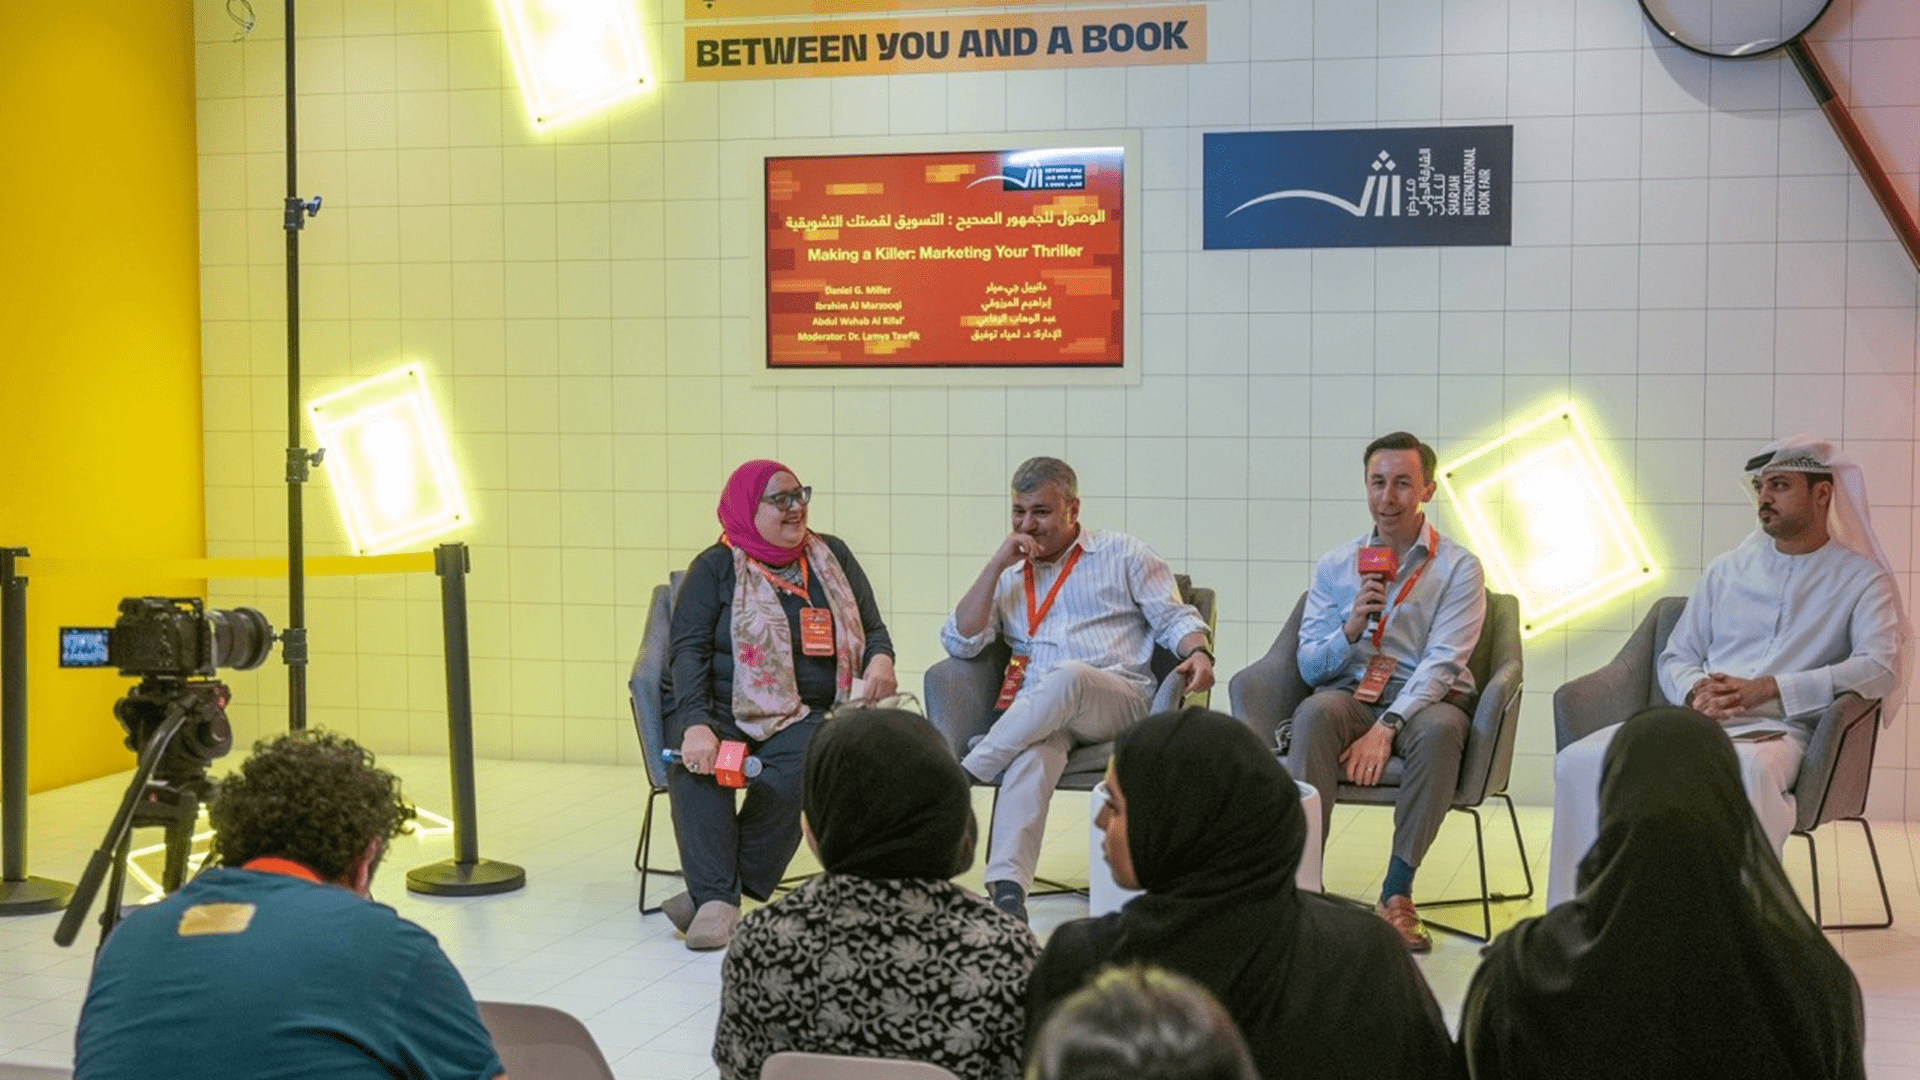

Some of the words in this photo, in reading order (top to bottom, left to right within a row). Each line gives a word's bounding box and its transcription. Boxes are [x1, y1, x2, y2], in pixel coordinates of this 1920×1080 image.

[696, 33, 867, 68] BETWEEN
[877, 31, 950, 62] YOU
[958, 26, 1039, 59] AND
[1046, 26, 1074, 55] A
[1082, 20, 1189, 53] BOOK
[1463, 147, 1476, 216] INTERNATIONAL
[1478, 168, 1491, 189] FAIR
[1448, 175, 1461, 216] SHARJAH
[1478, 190, 1490, 216] BOOK
[785, 214, 843, 232] التشويقية
[846, 213, 891, 228] لقصتك
[894, 212, 944, 230] التسويق
[955, 211, 1002, 231] الصحيح
[1005, 210, 1053, 227] للجمهور
[1057, 209, 1105, 227] الوصول
[808, 248, 859, 263] Making
[862, 250, 872, 260] a
[875, 247, 916, 260] Killer:
[919, 245, 992, 262] Marketing
[995, 245, 1029, 259] Your
[1032, 243, 1084, 258] Thriller
[825, 285, 853, 296] Daniel
[866, 285, 892, 295] Miller
[815, 301, 848, 311] Ibrahim
[850, 301, 860, 310] Al
[812, 316, 838, 326] Abdul
[839, 317, 870, 326] Wahab
[872, 316, 882, 325] Al
[797, 332, 846, 342] Moderator:
[848, 332, 861, 341] Dr.
